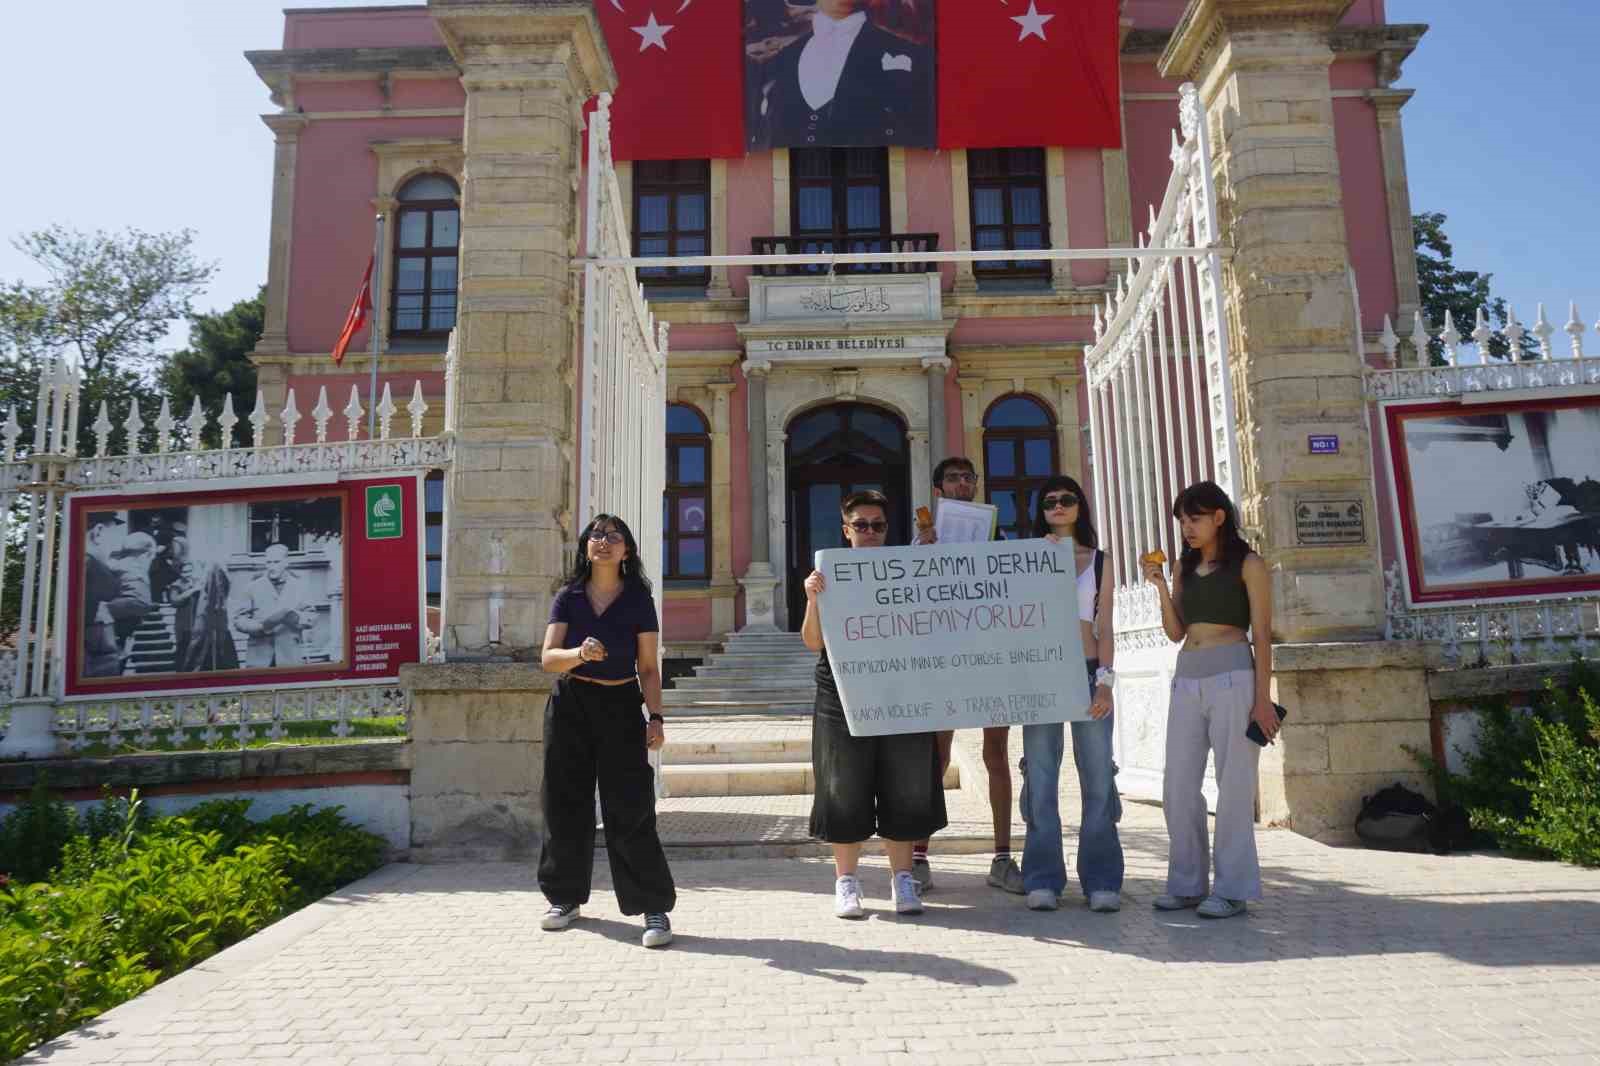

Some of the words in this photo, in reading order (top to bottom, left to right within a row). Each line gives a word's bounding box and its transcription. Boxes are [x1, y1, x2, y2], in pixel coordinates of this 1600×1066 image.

[787, 338, 831, 351] EDİRNE
[837, 336, 905, 350] BELEDİYESİ
[834, 559, 905, 582] ETUS
[912, 556, 975, 578] ZAMMI
[987, 550, 1065, 575] DERHAL
[875, 583, 920, 605] GERİ
[926, 577, 1009, 603] ÇEKİLSİN!
